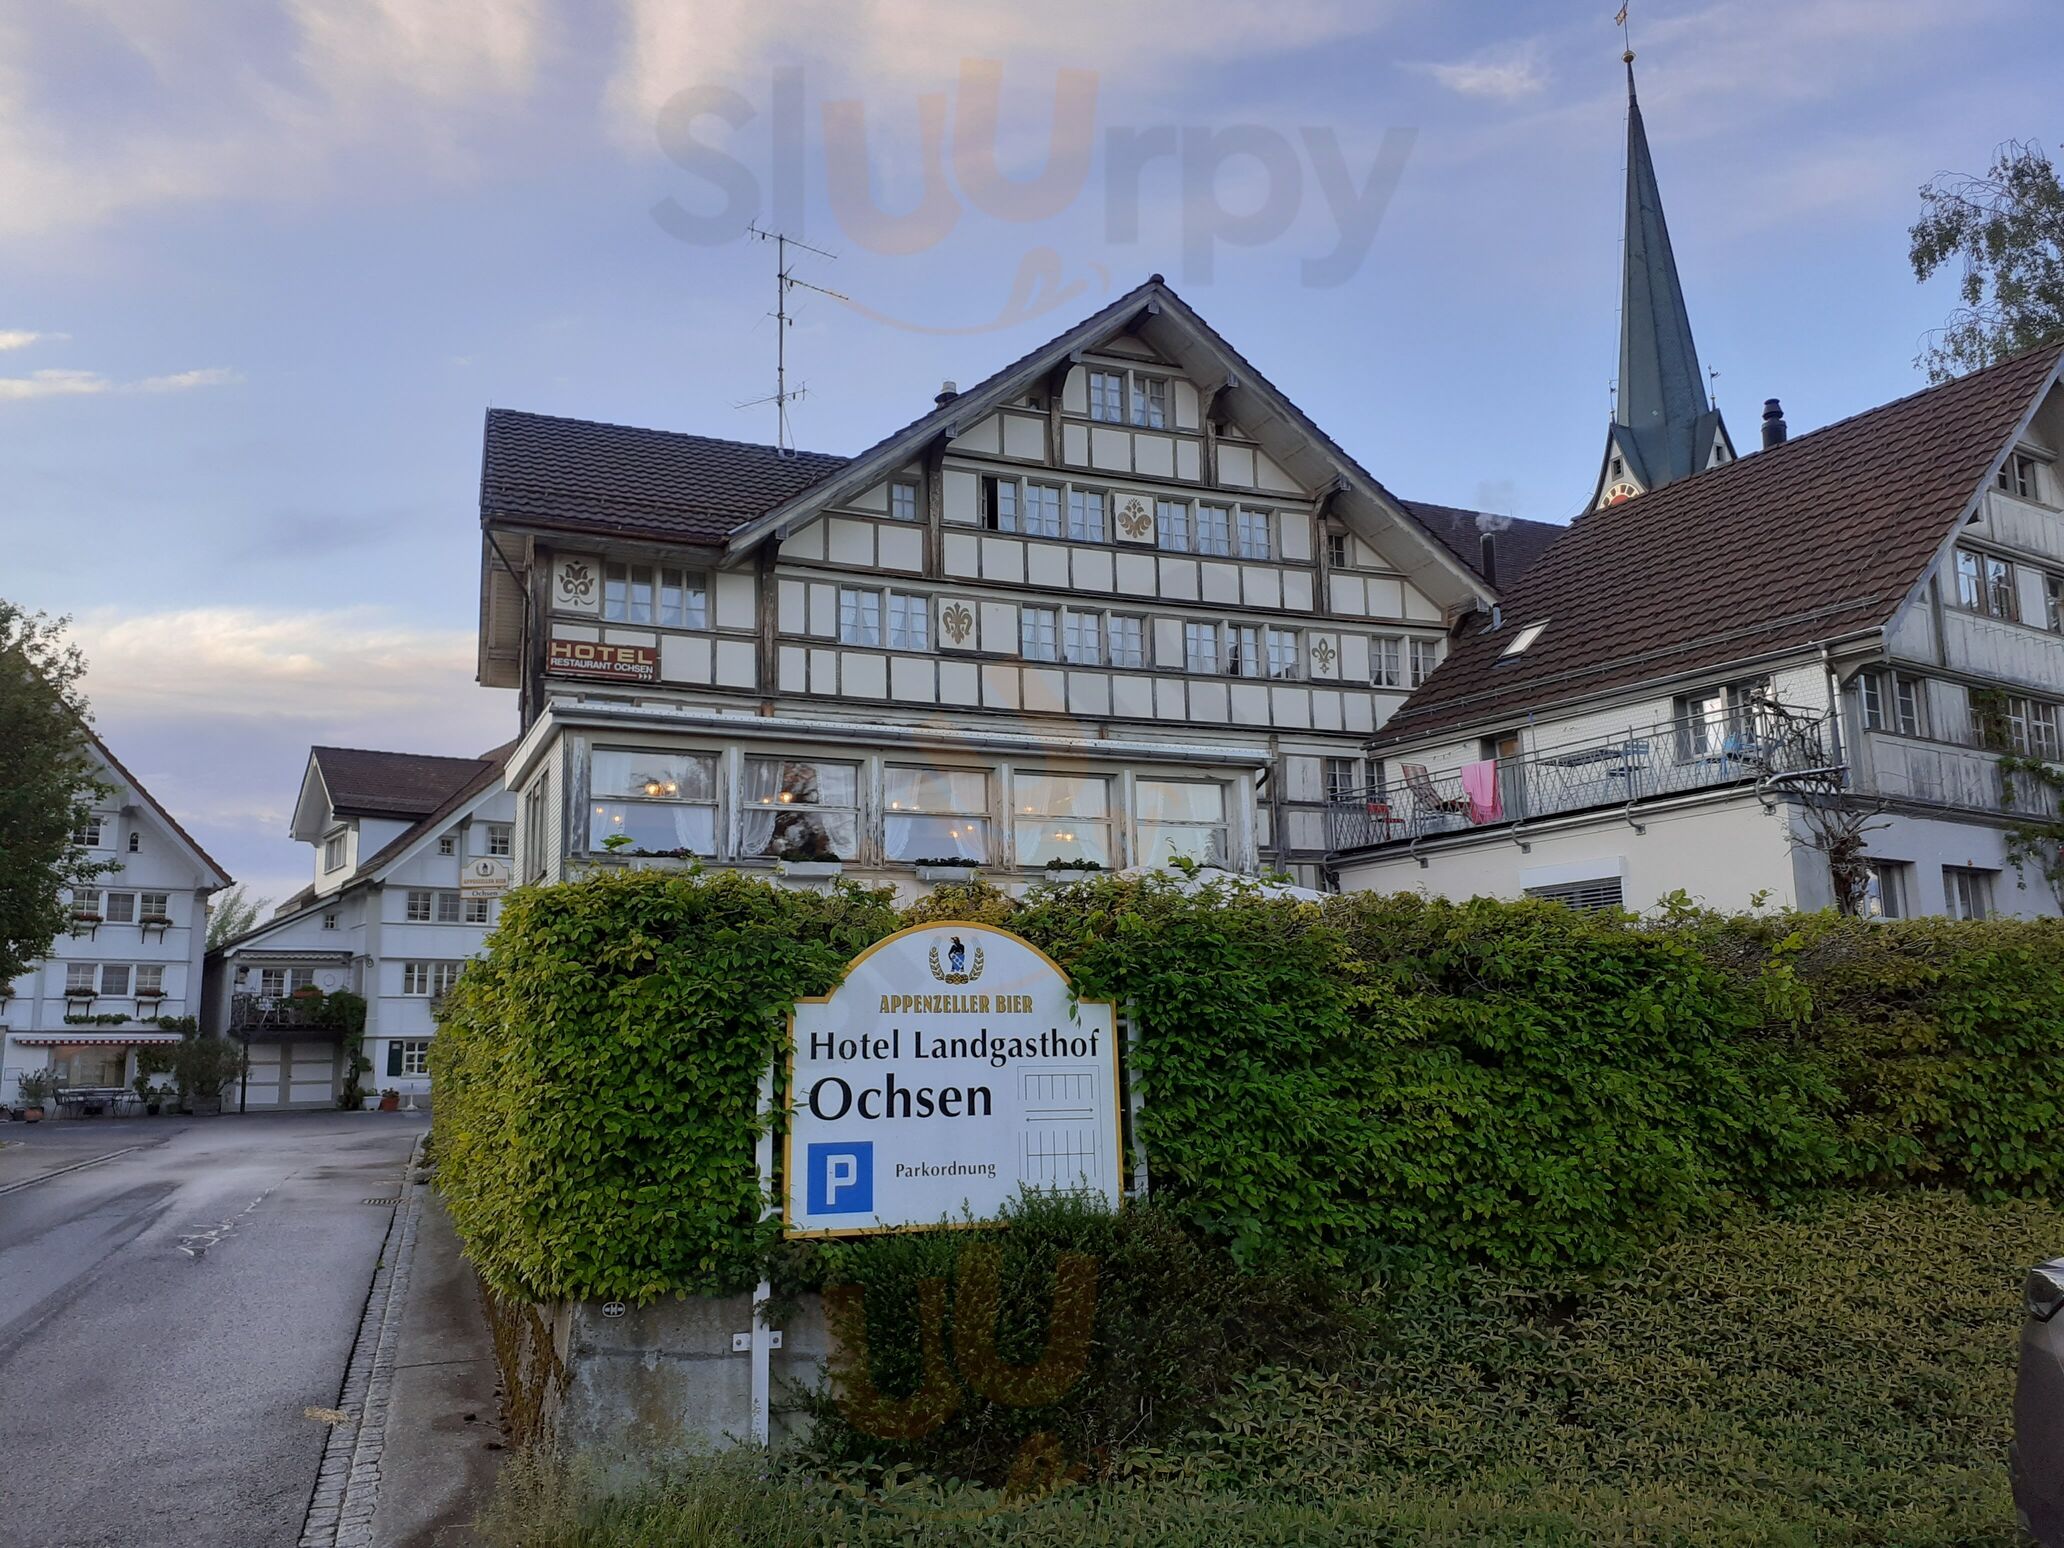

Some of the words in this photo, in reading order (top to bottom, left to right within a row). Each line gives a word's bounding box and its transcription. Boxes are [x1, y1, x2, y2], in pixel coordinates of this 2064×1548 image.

[551, 642, 653, 665] HOTEL
[550, 658, 612, 670] RESTAURANT
[614, 663, 653, 673] OCHSEN
[880, 995, 990, 1014] APPENZELLER
[995, 995, 1033, 1014] BIER
[810, 1029, 899, 1060] Hotel
[915, 1028, 1100, 1068] Landgasthof
[809, 1073, 992, 1121] Ochsen
[826, 1154, 857, 1205] P
[896, 1162, 996, 1178] Parkordnung
